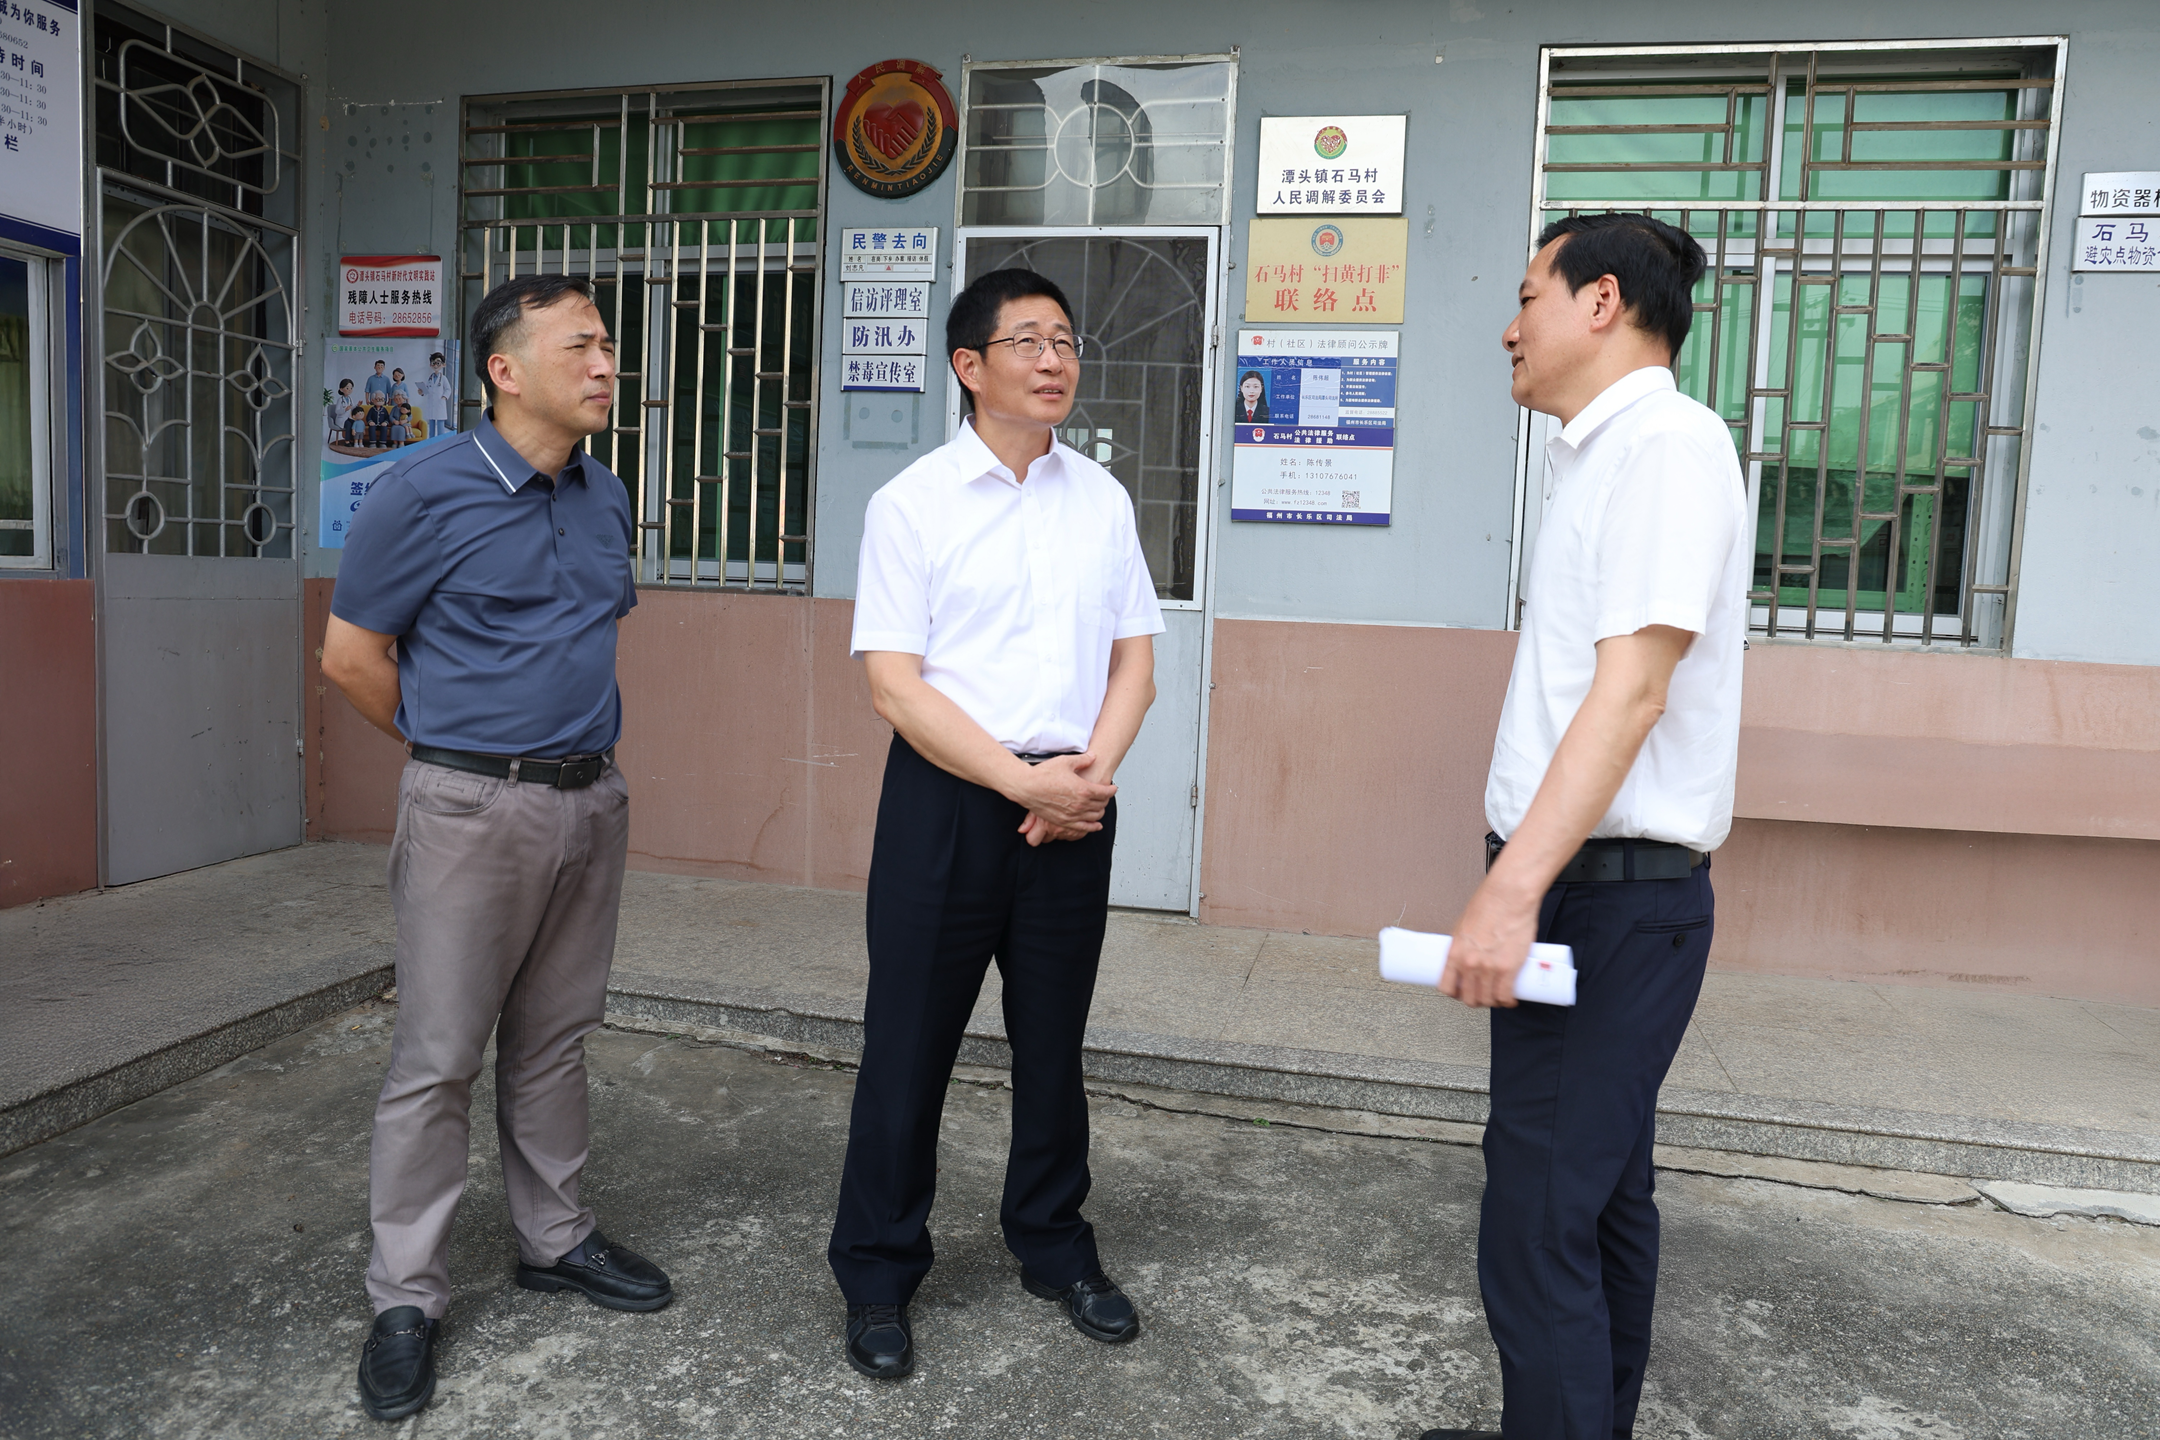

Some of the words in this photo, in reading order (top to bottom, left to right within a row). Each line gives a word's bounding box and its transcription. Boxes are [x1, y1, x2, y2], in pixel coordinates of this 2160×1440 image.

[857, 59, 926, 84] 人民调解
[4, 133, 19, 152] 栏
[847, 154, 943, 191] RENMINTIAOJIE
[1281, 167, 1378, 185] 潭头镇石马村
[1272, 188, 1386, 205] 人民调解委员会
[852, 232, 927, 250] 民警去向
[2084, 245, 2160, 266] 避灾点物资
[347, 289, 433, 305] 残障人士服务热线
[850, 286, 923, 312] 信访评理室
[1274, 287, 1377, 313] 联络点
[852, 325, 916, 347] 防汛办
[1262, 357, 1313, 367] 工作人员信息
[1352, 358, 1386, 366] 服务内容
[847, 360, 916, 383] 禁毒宣传室
[1273, 432, 1293, 440] 石马村
[1294, 429, 1334, 437] 公共法律服务
[1335, 433, 1356, 441] 联络点
[1266, 511, 1353, 521] 福州市长乐区司法局
